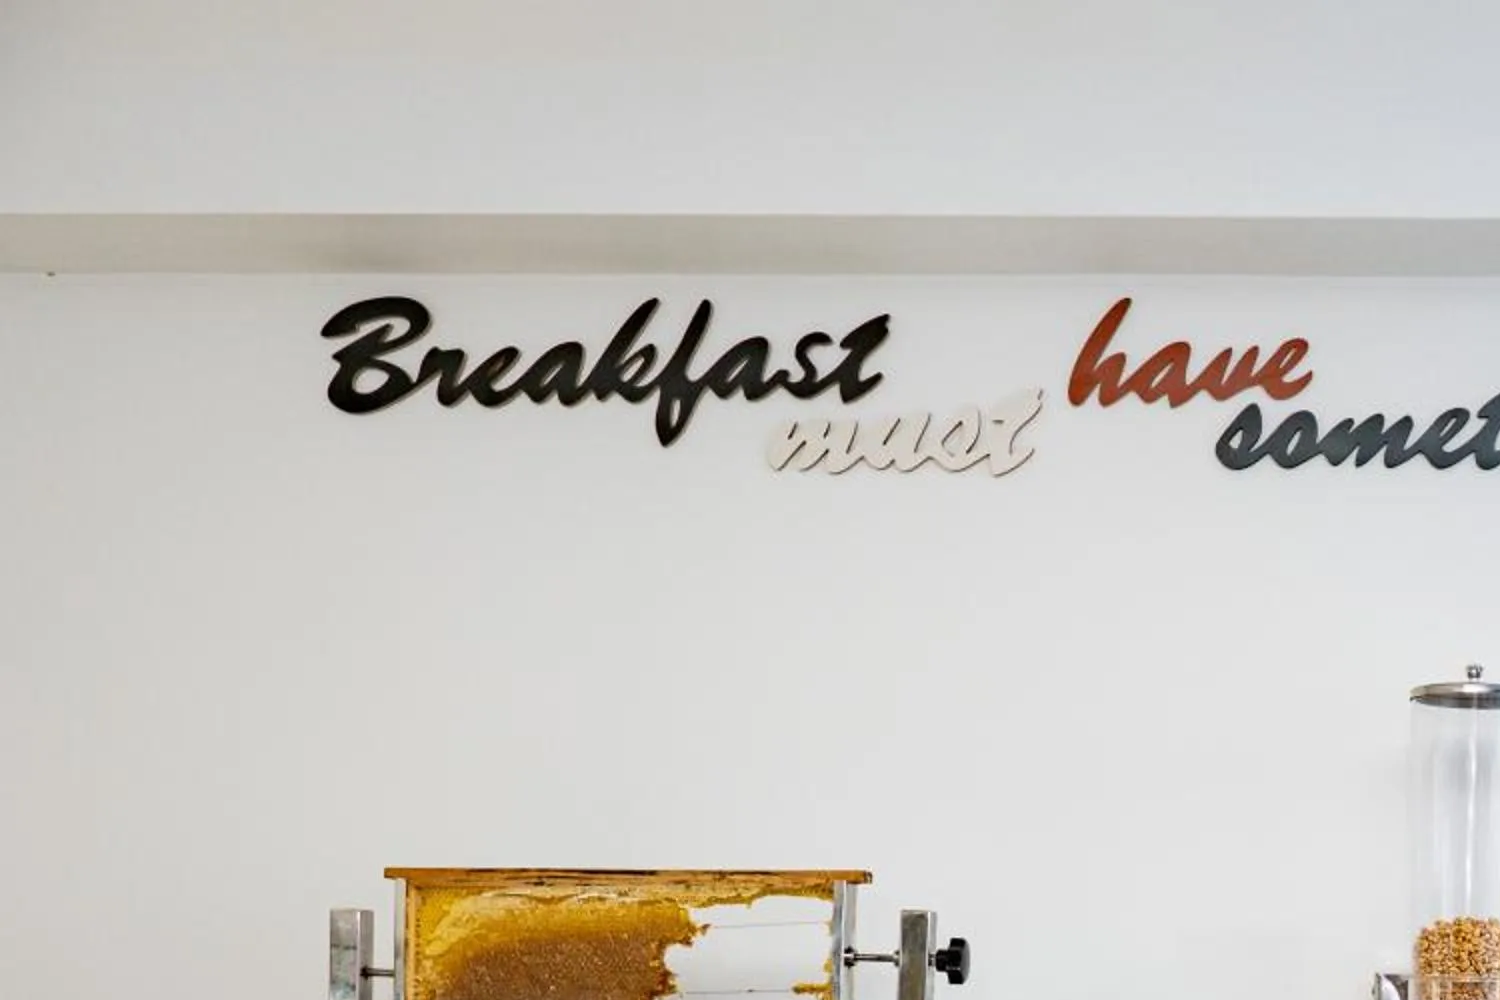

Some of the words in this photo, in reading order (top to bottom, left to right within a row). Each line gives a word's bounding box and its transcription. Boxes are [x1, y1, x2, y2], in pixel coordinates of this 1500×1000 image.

[320, 295, 891, 448] Breakfast
[767, 388, 1043, 477] must
[1067, 297, 1314, 407] have
